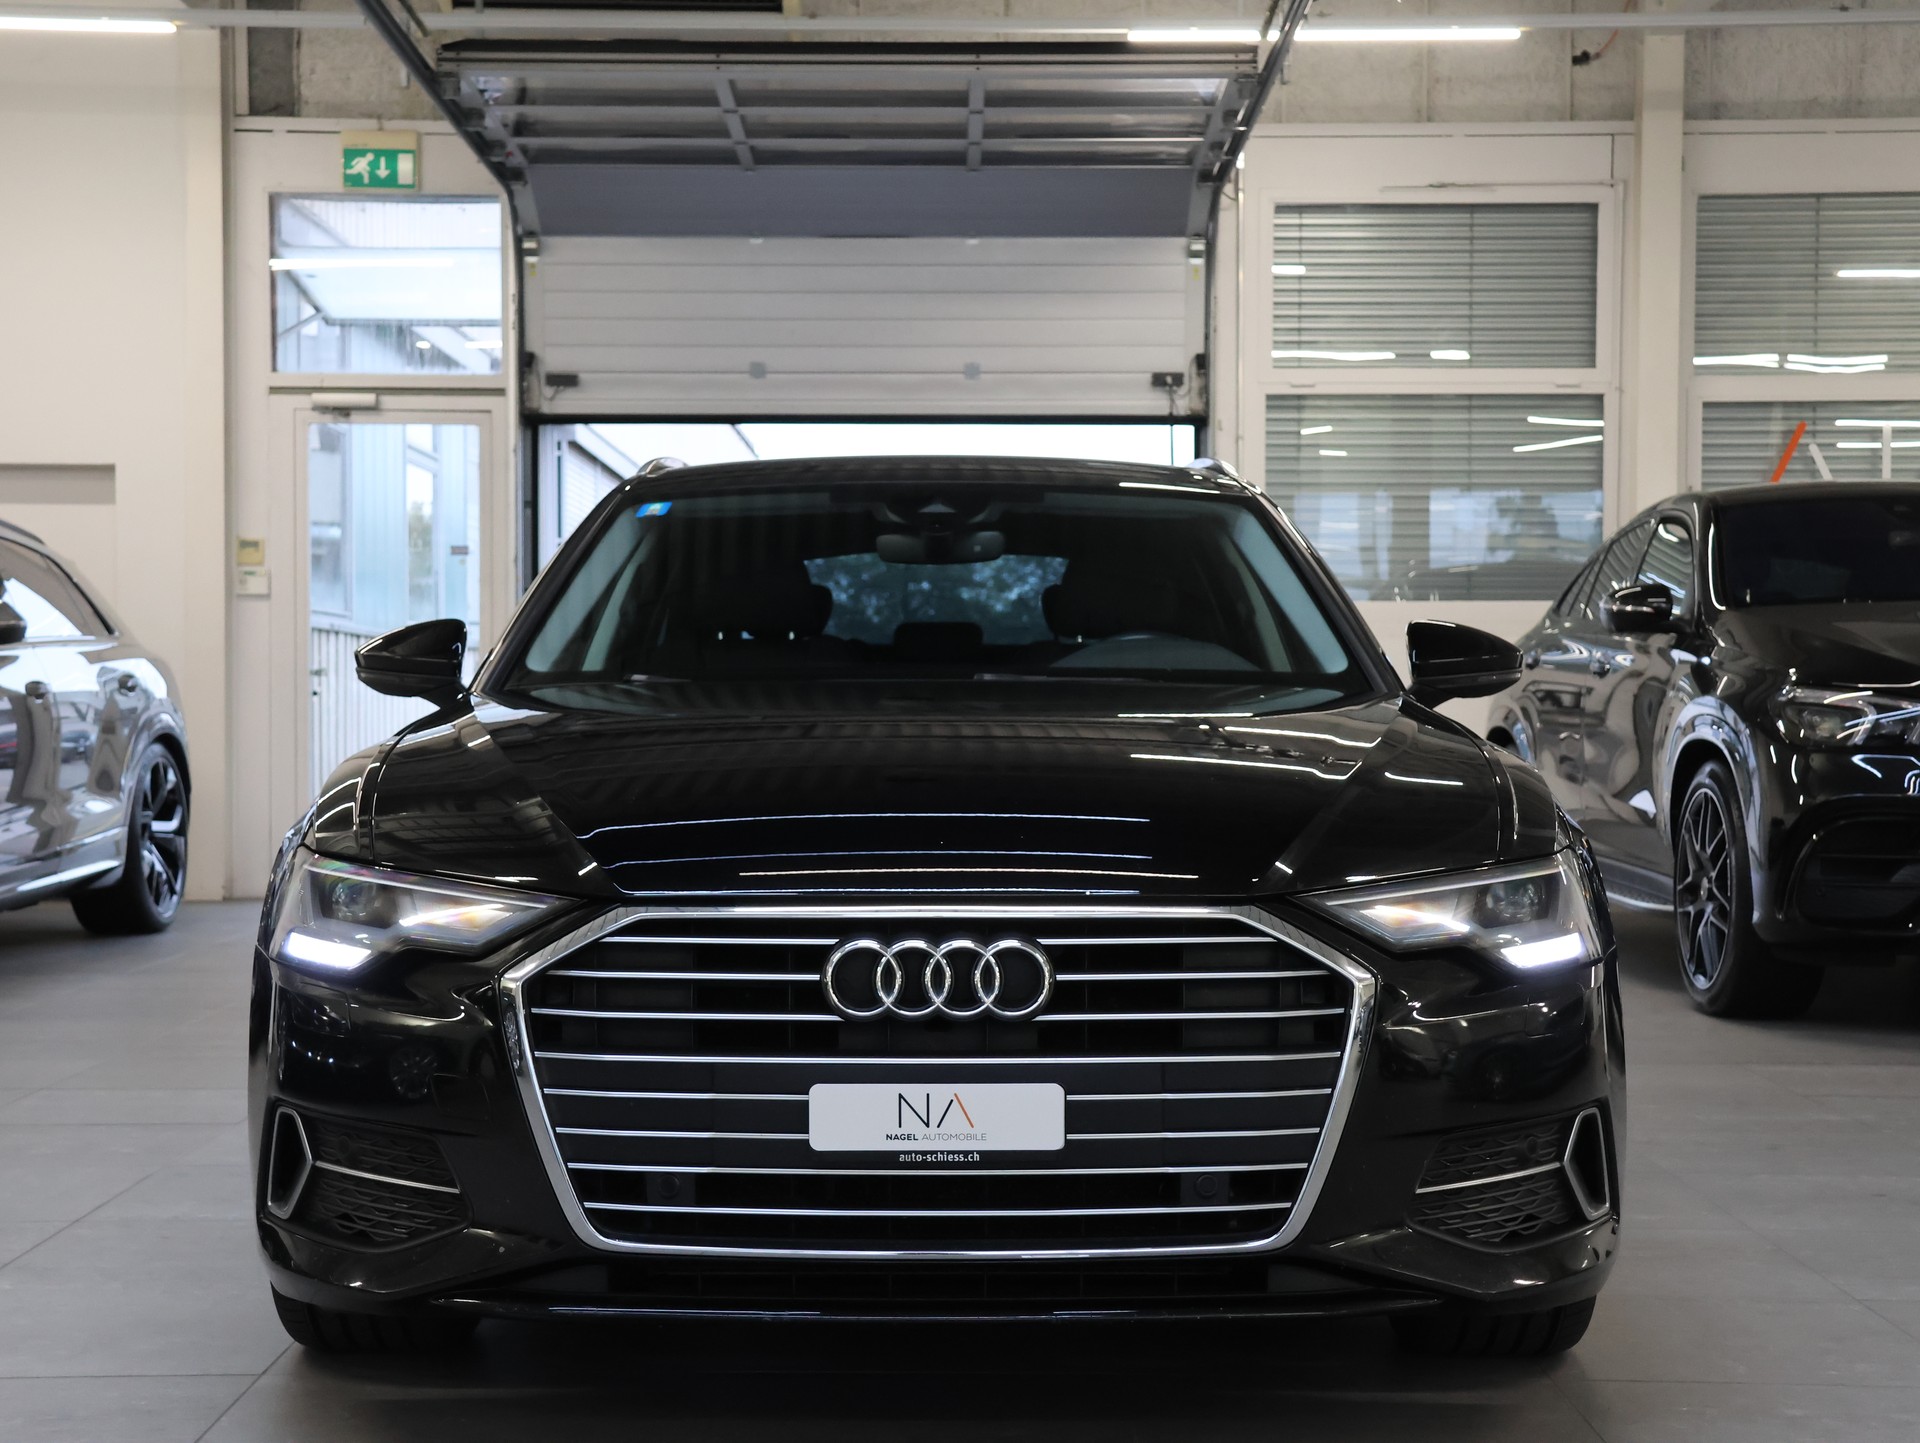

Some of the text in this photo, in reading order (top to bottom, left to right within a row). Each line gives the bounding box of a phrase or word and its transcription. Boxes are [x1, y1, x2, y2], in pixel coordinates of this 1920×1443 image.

[885, 1133, 987, 1141] NAGEL AUTOMOBILE
[899, 1151, 980, 1162] auto-schiess.ch
